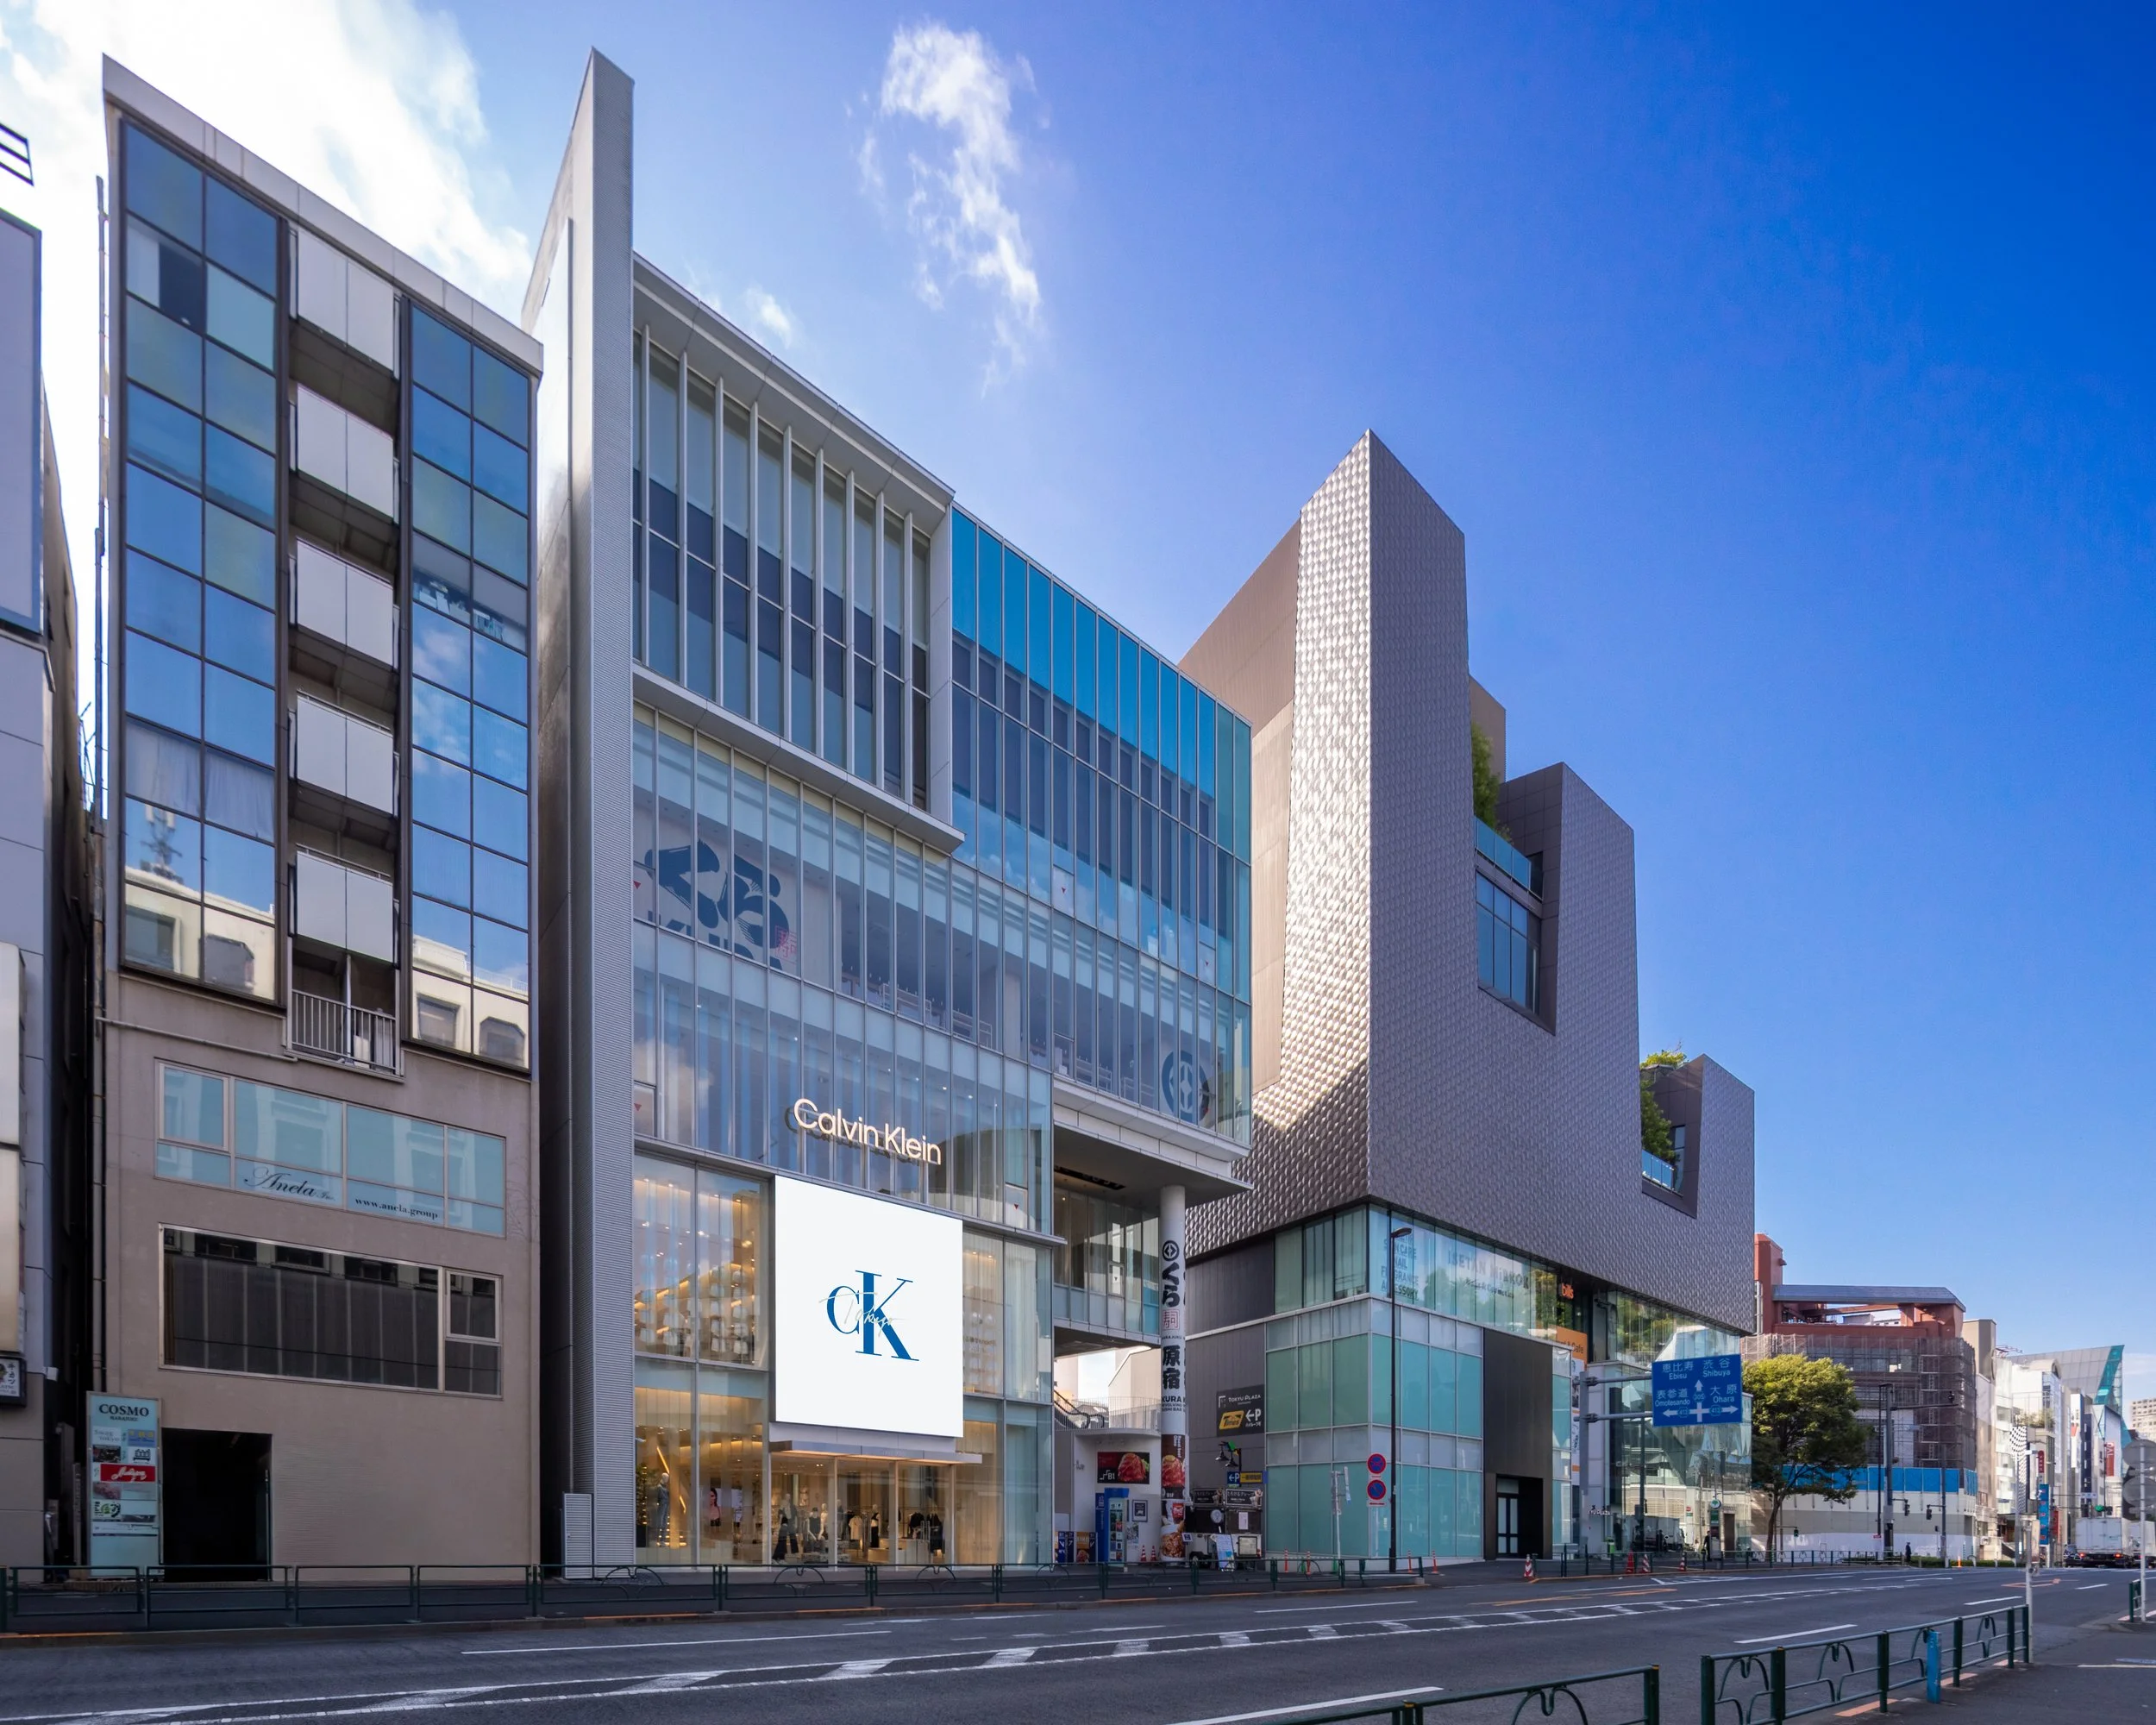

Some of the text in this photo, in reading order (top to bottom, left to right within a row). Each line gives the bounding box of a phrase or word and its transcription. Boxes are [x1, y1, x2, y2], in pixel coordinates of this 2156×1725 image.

[793, 1098, 942, 1165] Calvin Klein
[243, 1166, 317, 1198] Anela
[354, 1197, 438, 1220] www.anela.group
[1162, 1261, 1181, 1308] くら
[1562, 1283, 1574, 1300] bills
[1162, 1345, 1181, 1389] 原宿
[1662, 1361, 1694, 1373] 恵比寿
[1702, 1358, 1730, 1370] 渋谷
[1657, 1388, 1688, 1400] 表参道
[1710, 1383, 1738, 1396] 大原
[98, 1403, 149, 1417] COSMO
[1255, 1408, 1262, 1421] P
[1234, 1473, 1239, 1482] P
